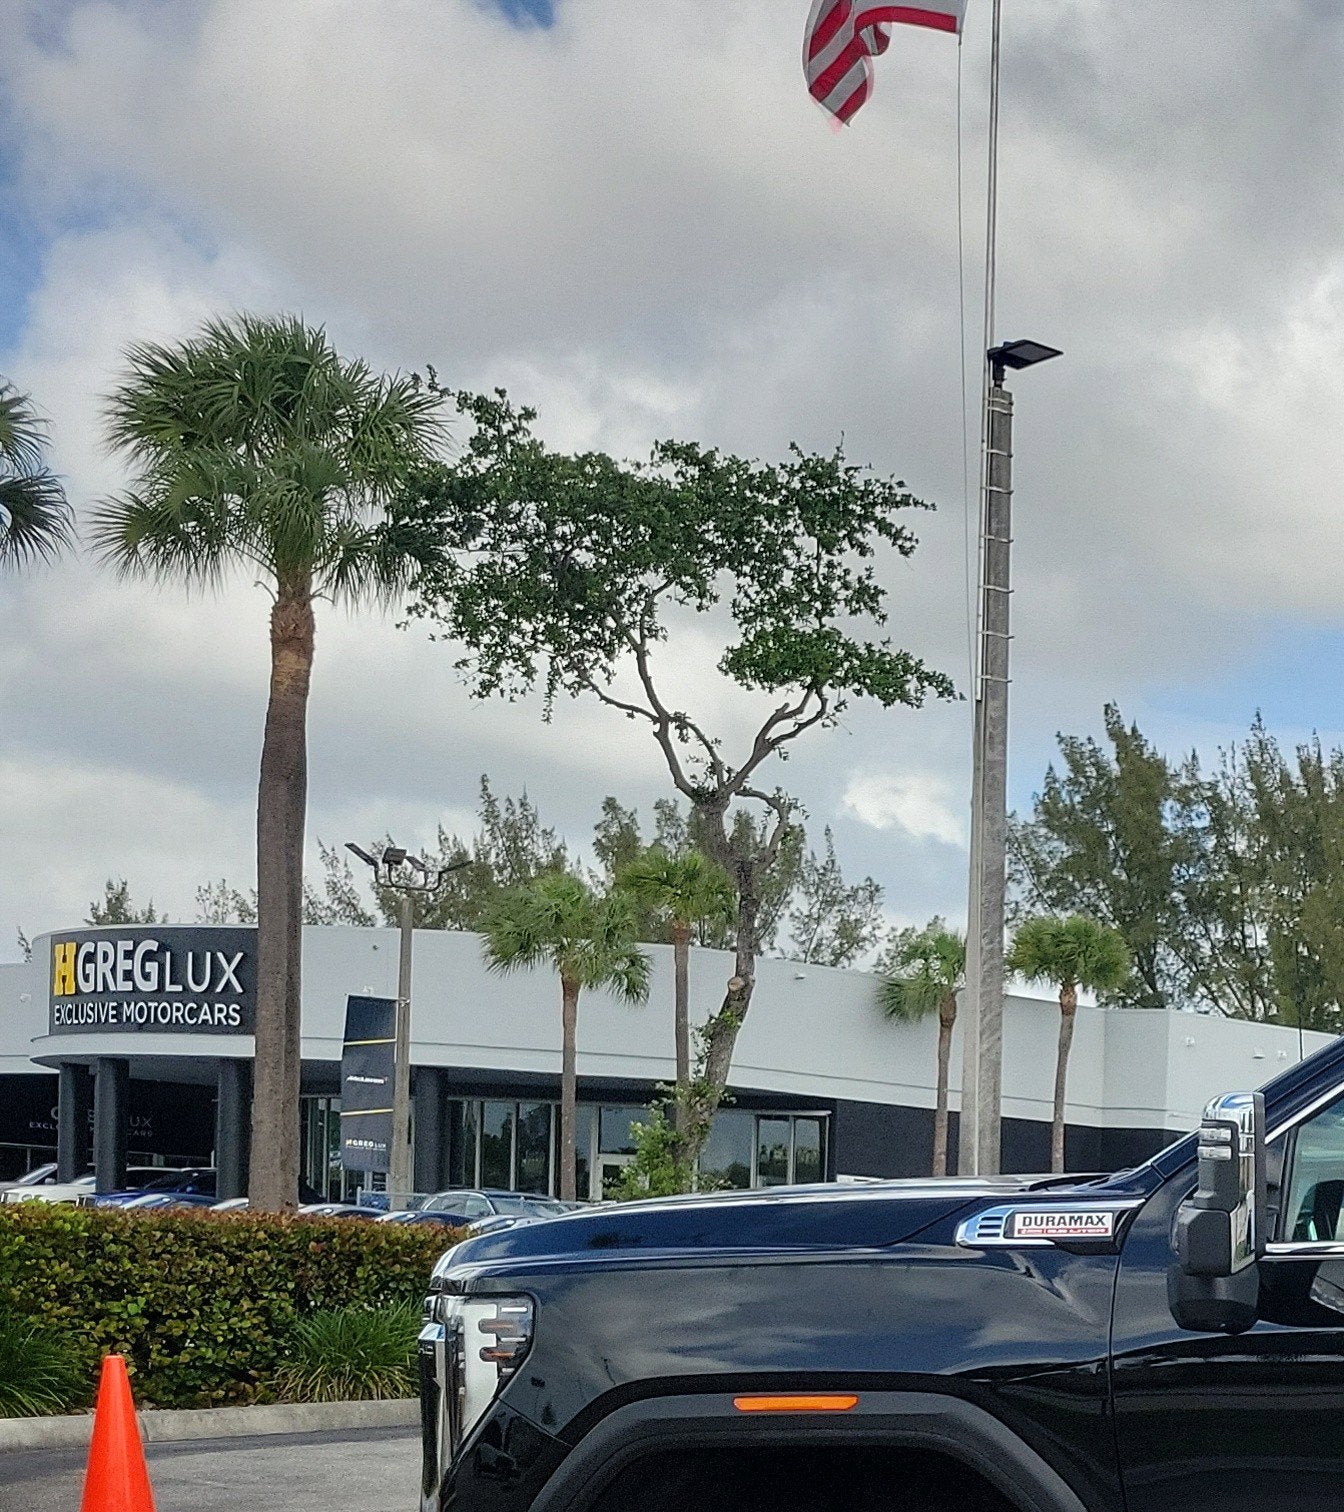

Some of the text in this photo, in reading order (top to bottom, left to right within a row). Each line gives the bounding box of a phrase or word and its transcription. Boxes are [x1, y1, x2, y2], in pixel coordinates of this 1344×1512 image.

[54, 1001, 241, 1026] EXCLUSIVE MOTORCARS
[1022, 1215, 1106, 1227] DURAMAX
